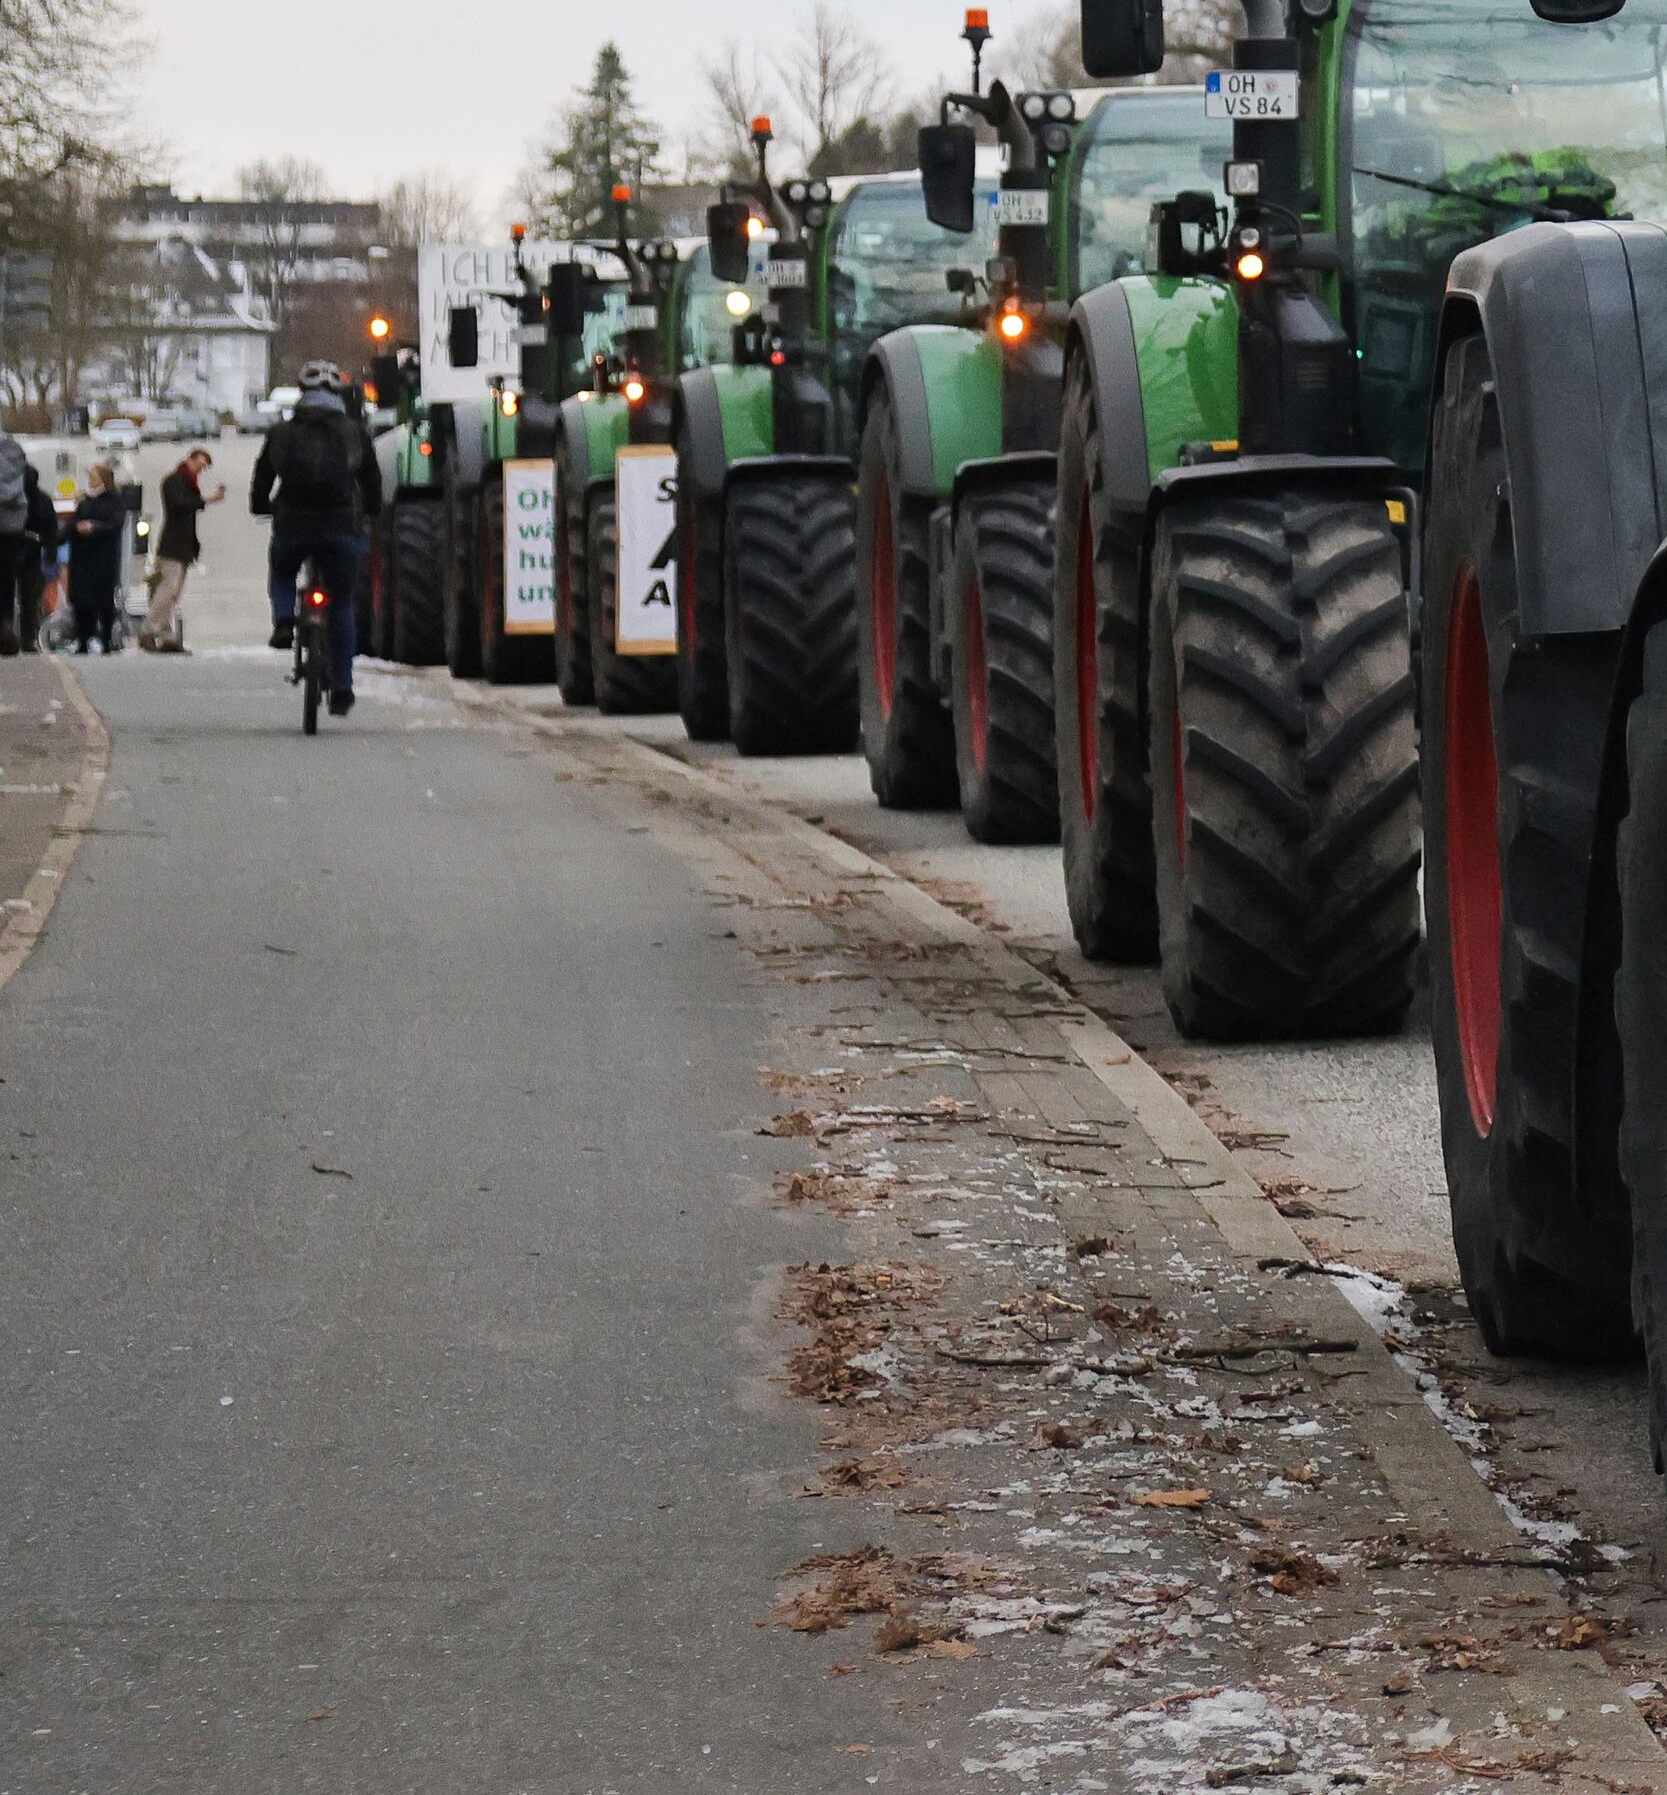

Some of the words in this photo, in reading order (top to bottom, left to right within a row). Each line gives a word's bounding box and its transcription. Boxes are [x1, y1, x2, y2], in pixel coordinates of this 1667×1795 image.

[1228, 74, 1255, 93] OH
[1224, 96, 1251, 115] VS
[1257, 96, 1282, 115] 84
[441, 251, 490, 287] ICH
